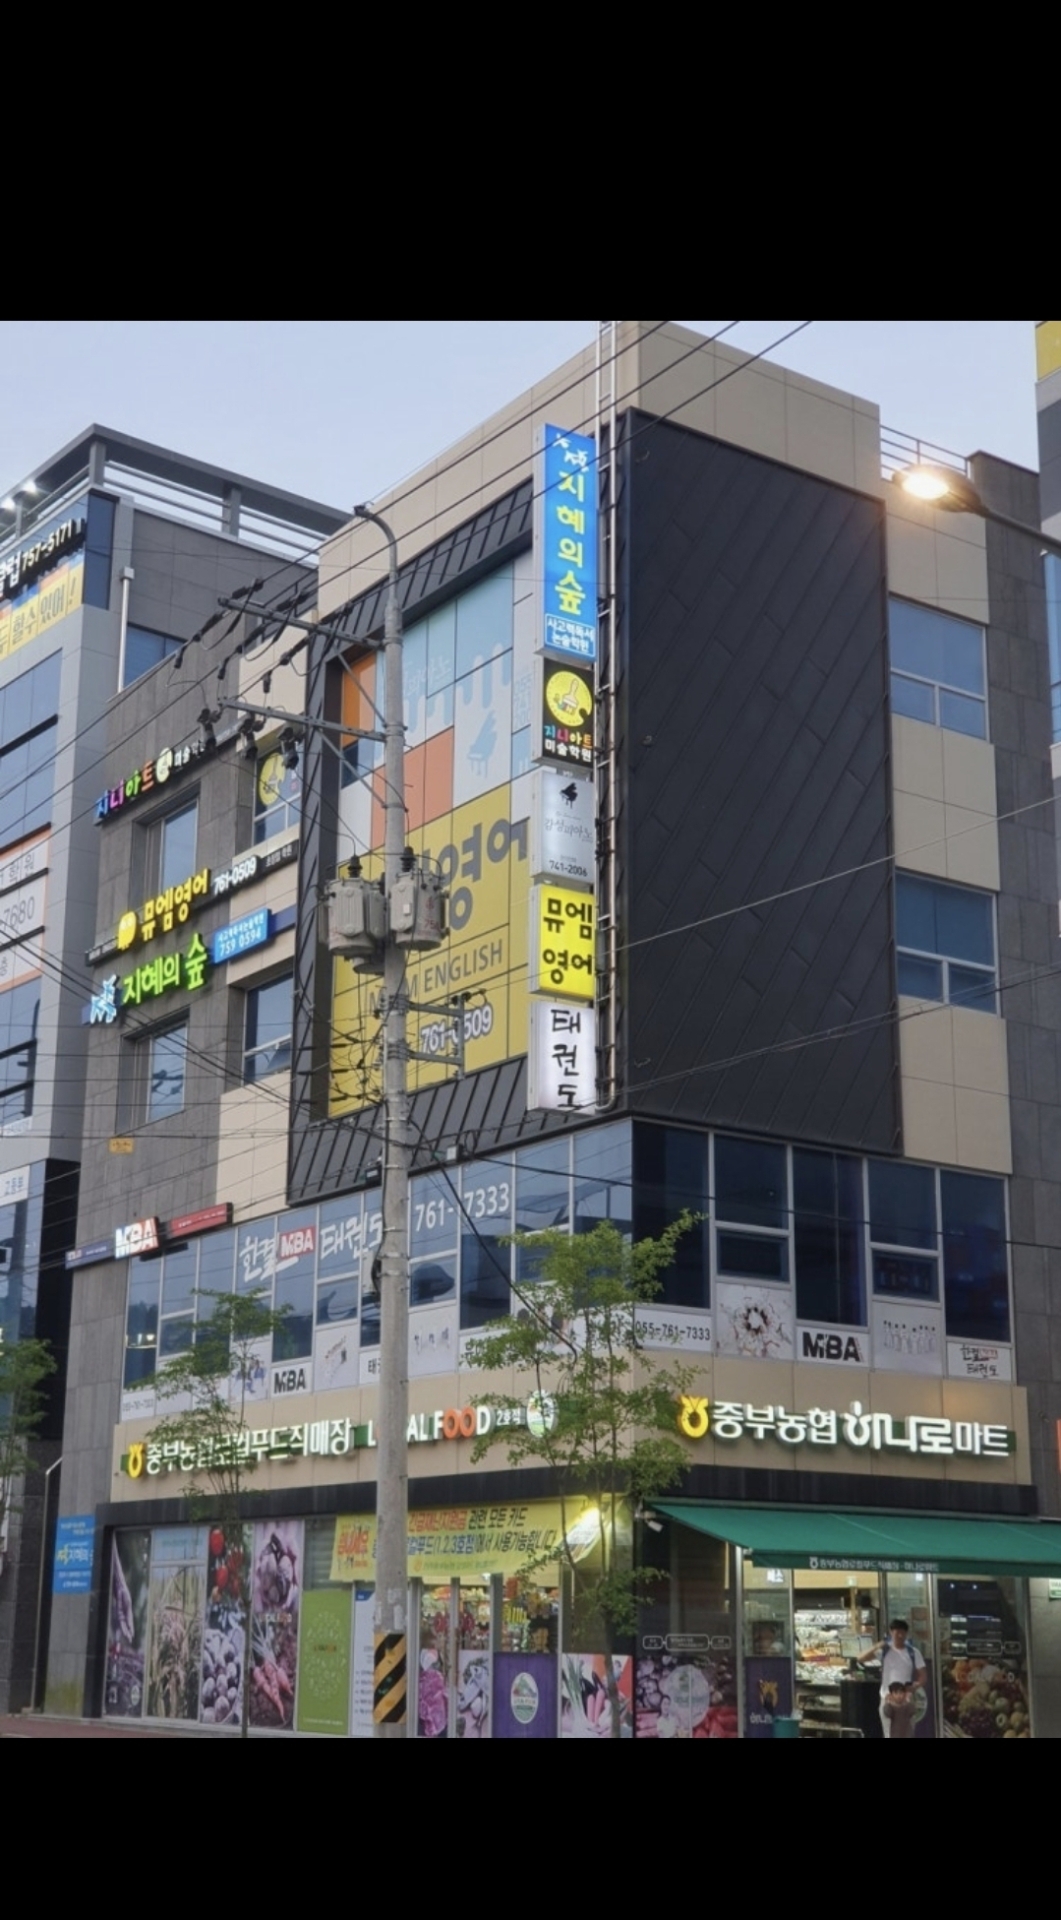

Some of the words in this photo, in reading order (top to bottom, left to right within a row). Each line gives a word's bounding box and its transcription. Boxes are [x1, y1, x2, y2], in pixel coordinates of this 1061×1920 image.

[544, 724, 593, 750] 지니아트
[544, 738, 592, 763] 미술학원
[95, 760, 155, 821] 지니아트
[548, 859, 589, 878] 741-2006
[141, 868, 211, 941] 뮤엠영어
[213, 854, 258, 896] 761-0509
[543, 897, 593, 940] 뮤엠
[219, 941, 236, 958] 759
[238, 927, 262, 949] 0594
[122, 953, 181, 1005] 지혜의
[184, 932, 208, 991] 숲
[423, 938, 503, 995] ENGLISH
[542, 948, 593, 985] 영어
[550, 1008, 583, 1111] 태권도
[114, 1217, 160, 1260] MBA
[280, 1228, 314, 1258] MBA
[635, 1320, 711, 1341] 055-761-7333
[802, 1331, 863, 1363] MBA
[273, 1367, 307, 1395] MBA
[367, 1410, 430, 1447] LAL
[433, 1403, 494, 1440] FOOD
[712, 1400, 838, 1446] 중부농협
